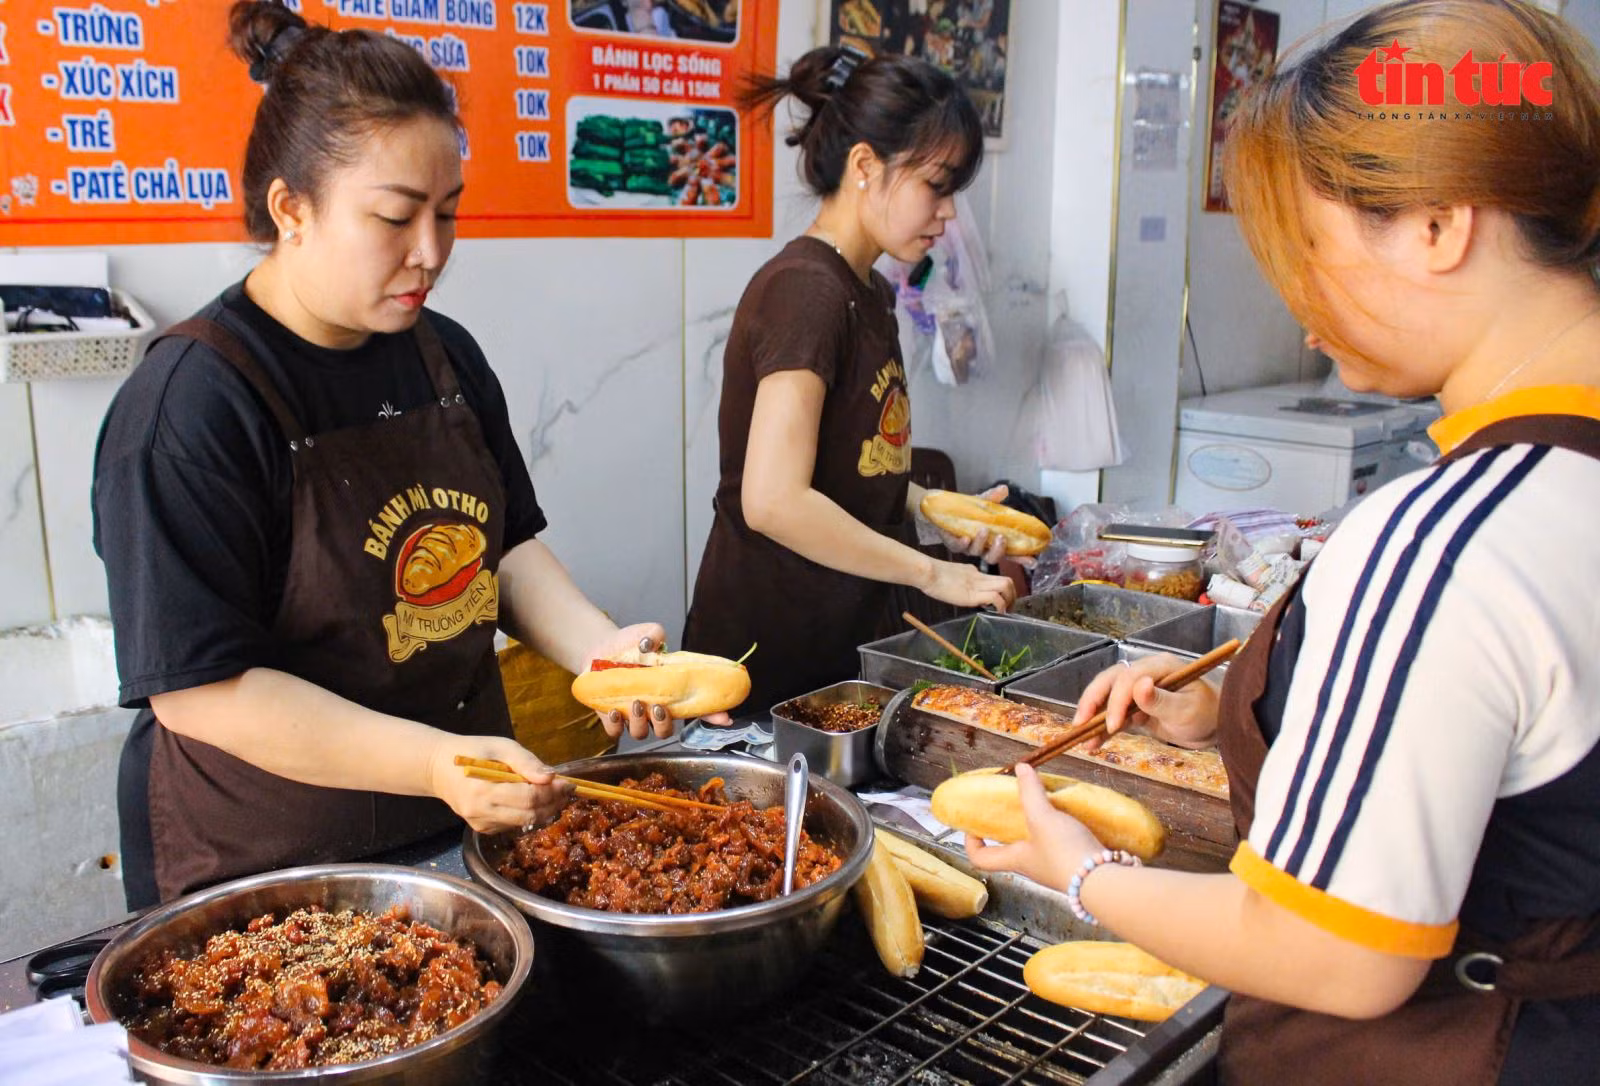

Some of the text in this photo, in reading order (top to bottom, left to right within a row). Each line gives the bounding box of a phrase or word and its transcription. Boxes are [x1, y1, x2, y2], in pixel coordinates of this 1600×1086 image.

[58, 7, 140, 45] TRỨNG
[516, 6, 545, 31] 12K
[517, 49, 546, 74] 10K
[591, 44, 639, 68] BÁNH
[642, 51, 673, 75] LỌC
[63, 59, 112, 96] XÚC
[120, 63, 175, 99] XÍCH
[517, 91, 547, 116] 10K
[518, 134, 547, 158] 10K
[71, 164, 127, 199] PATÊ
[134, 161, 180, 199] CHẢ
[186, 171, 229, 206] LỤA
[364, 493, 413, 560] BÁNH
[432, 487, 489, 524] OTHO
